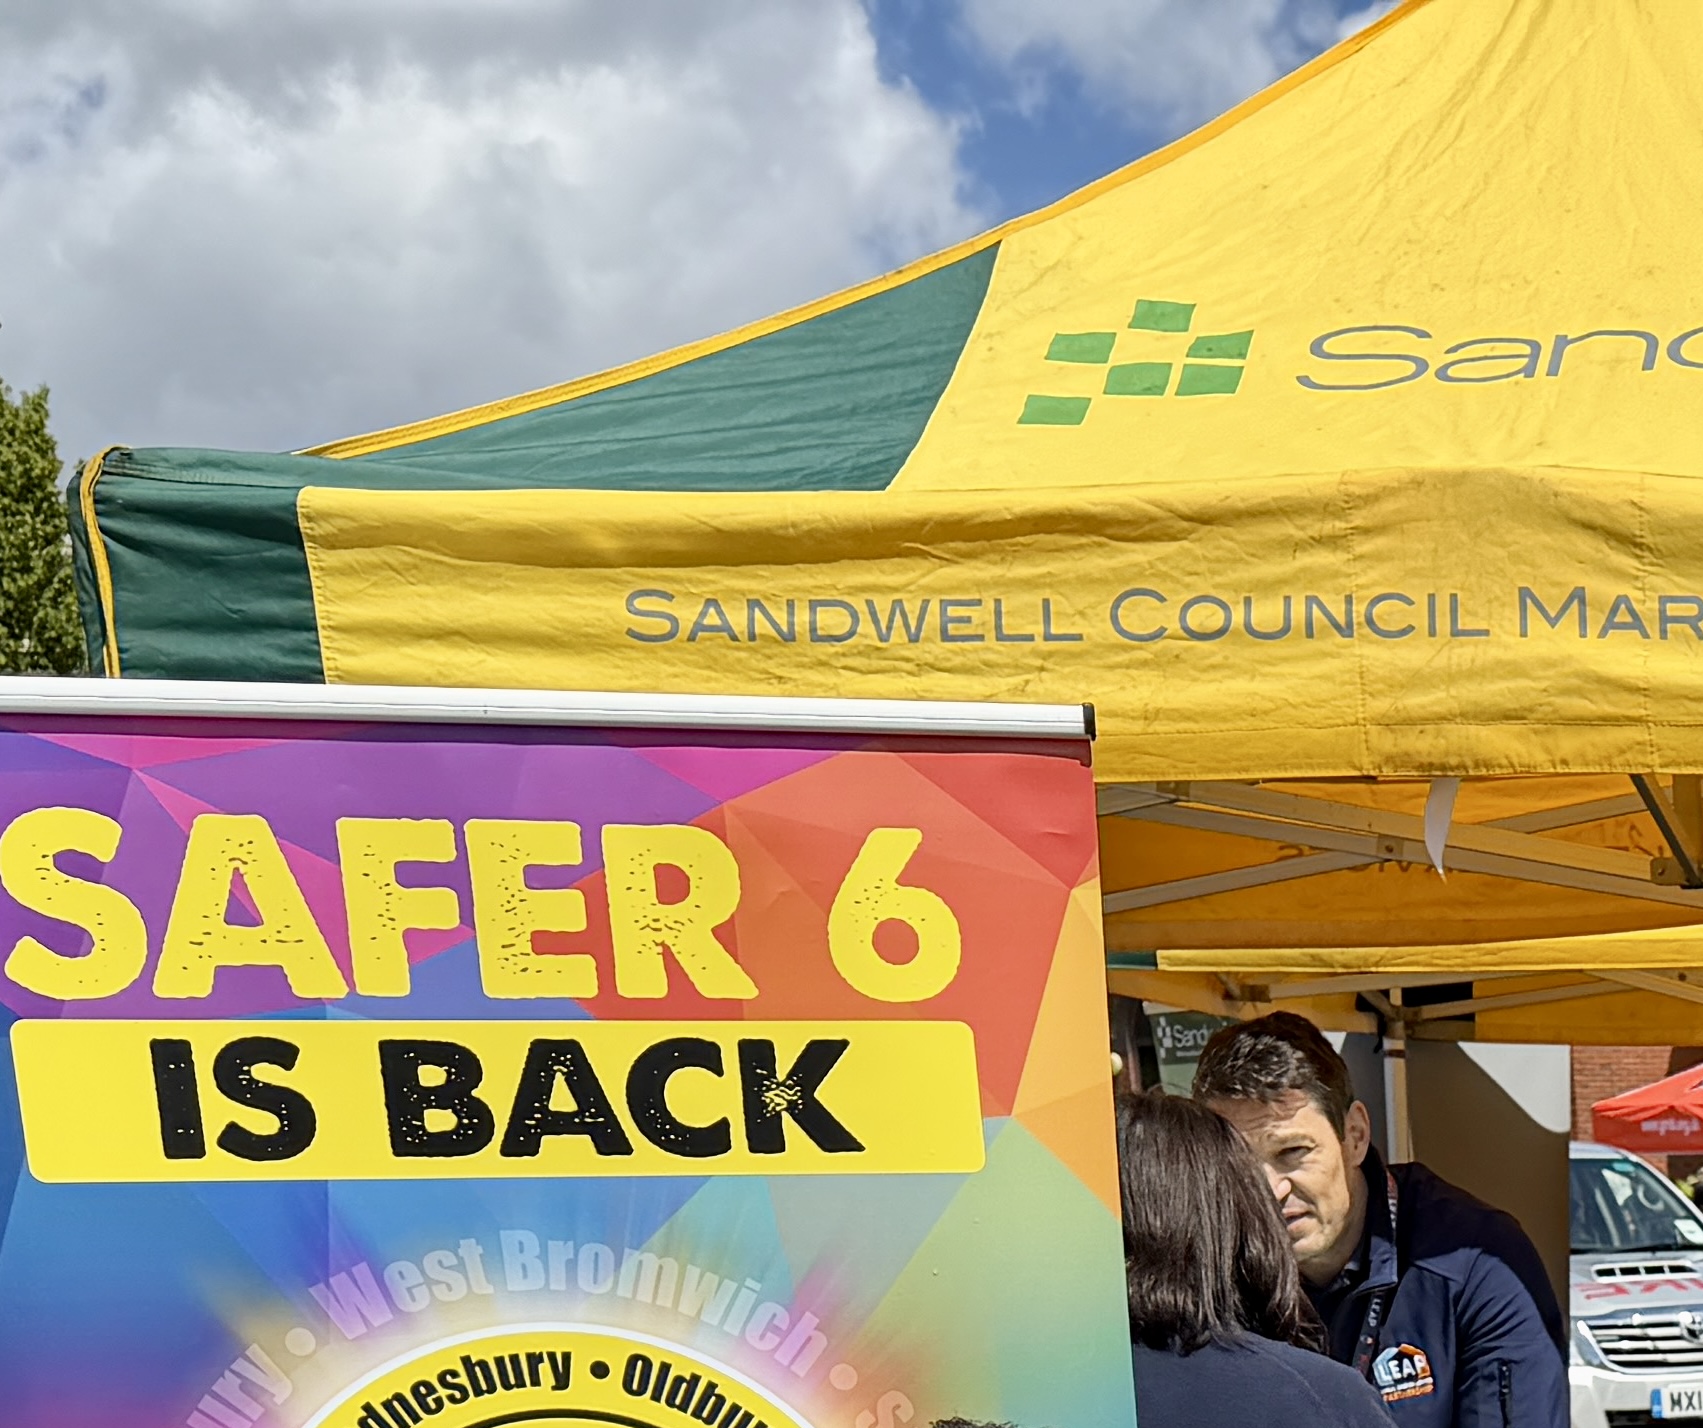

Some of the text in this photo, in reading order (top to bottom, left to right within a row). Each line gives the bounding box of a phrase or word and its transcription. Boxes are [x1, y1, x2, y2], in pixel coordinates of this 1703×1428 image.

[625, 588, 1084, 645] SANDWELL
[1110, 587, 1490, 642] COUNCIL
[0, 805, 962, 1001] SAFER 6
[1172, 1024, 1209, 1048] Sand
[149, 1036, 866, 1161] IS BACK
[308, 1228, 832, 1379] West Bromwich
[1378, 1355, 1427, 1382] LEAP
